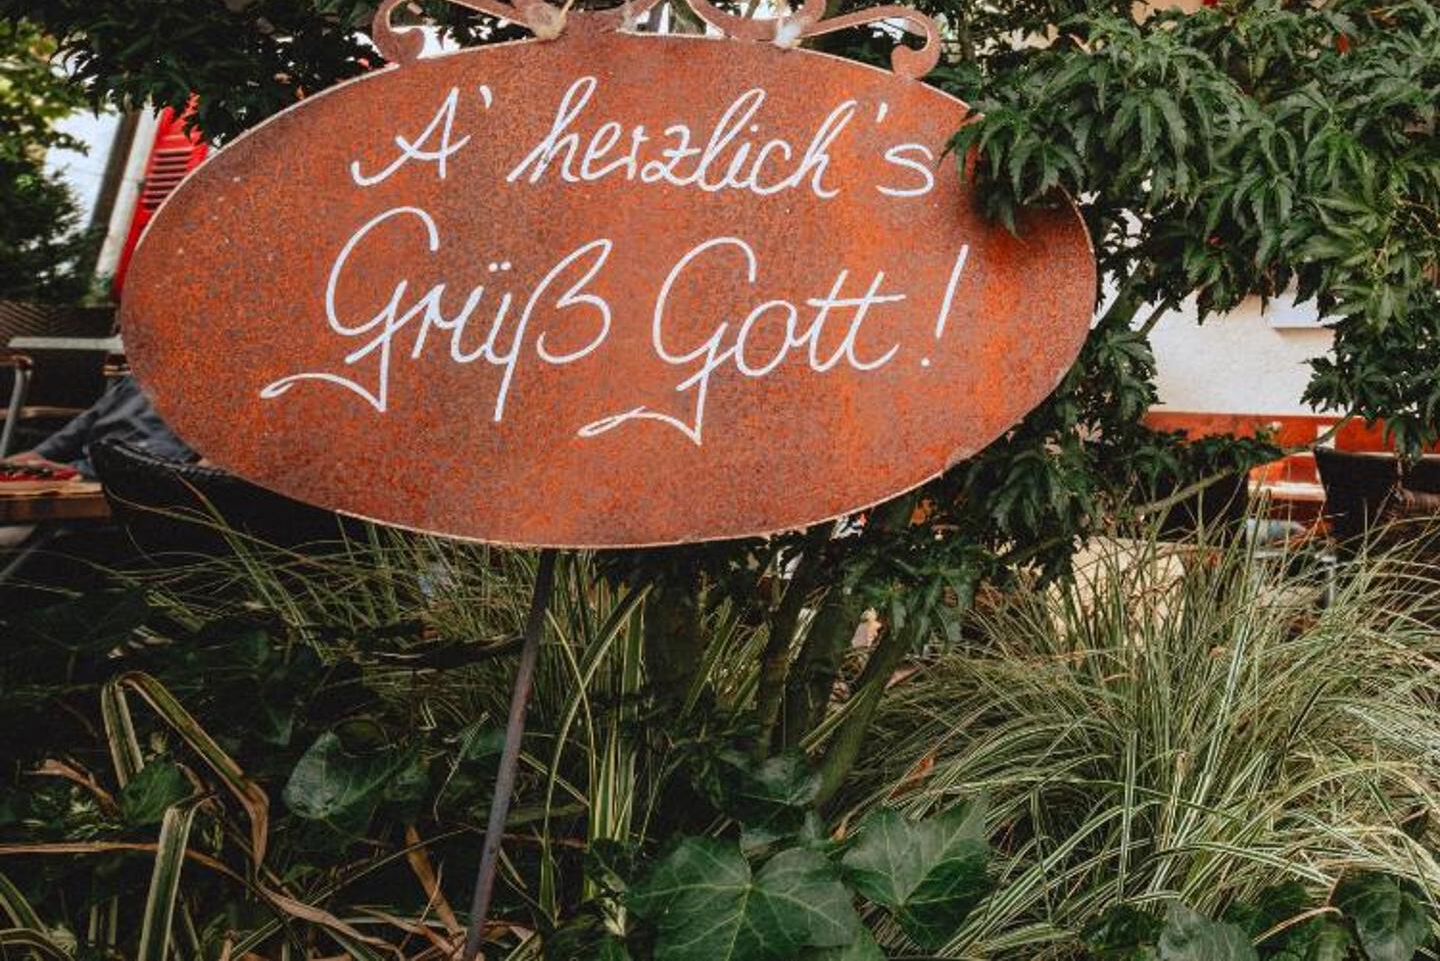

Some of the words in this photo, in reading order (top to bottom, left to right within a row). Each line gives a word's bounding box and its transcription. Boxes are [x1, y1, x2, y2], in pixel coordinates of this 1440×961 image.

[350, 84, 495, 187] A'
[507, 75, 935, 198] herzlich's
[260, 206, 613, 422] Grüß
